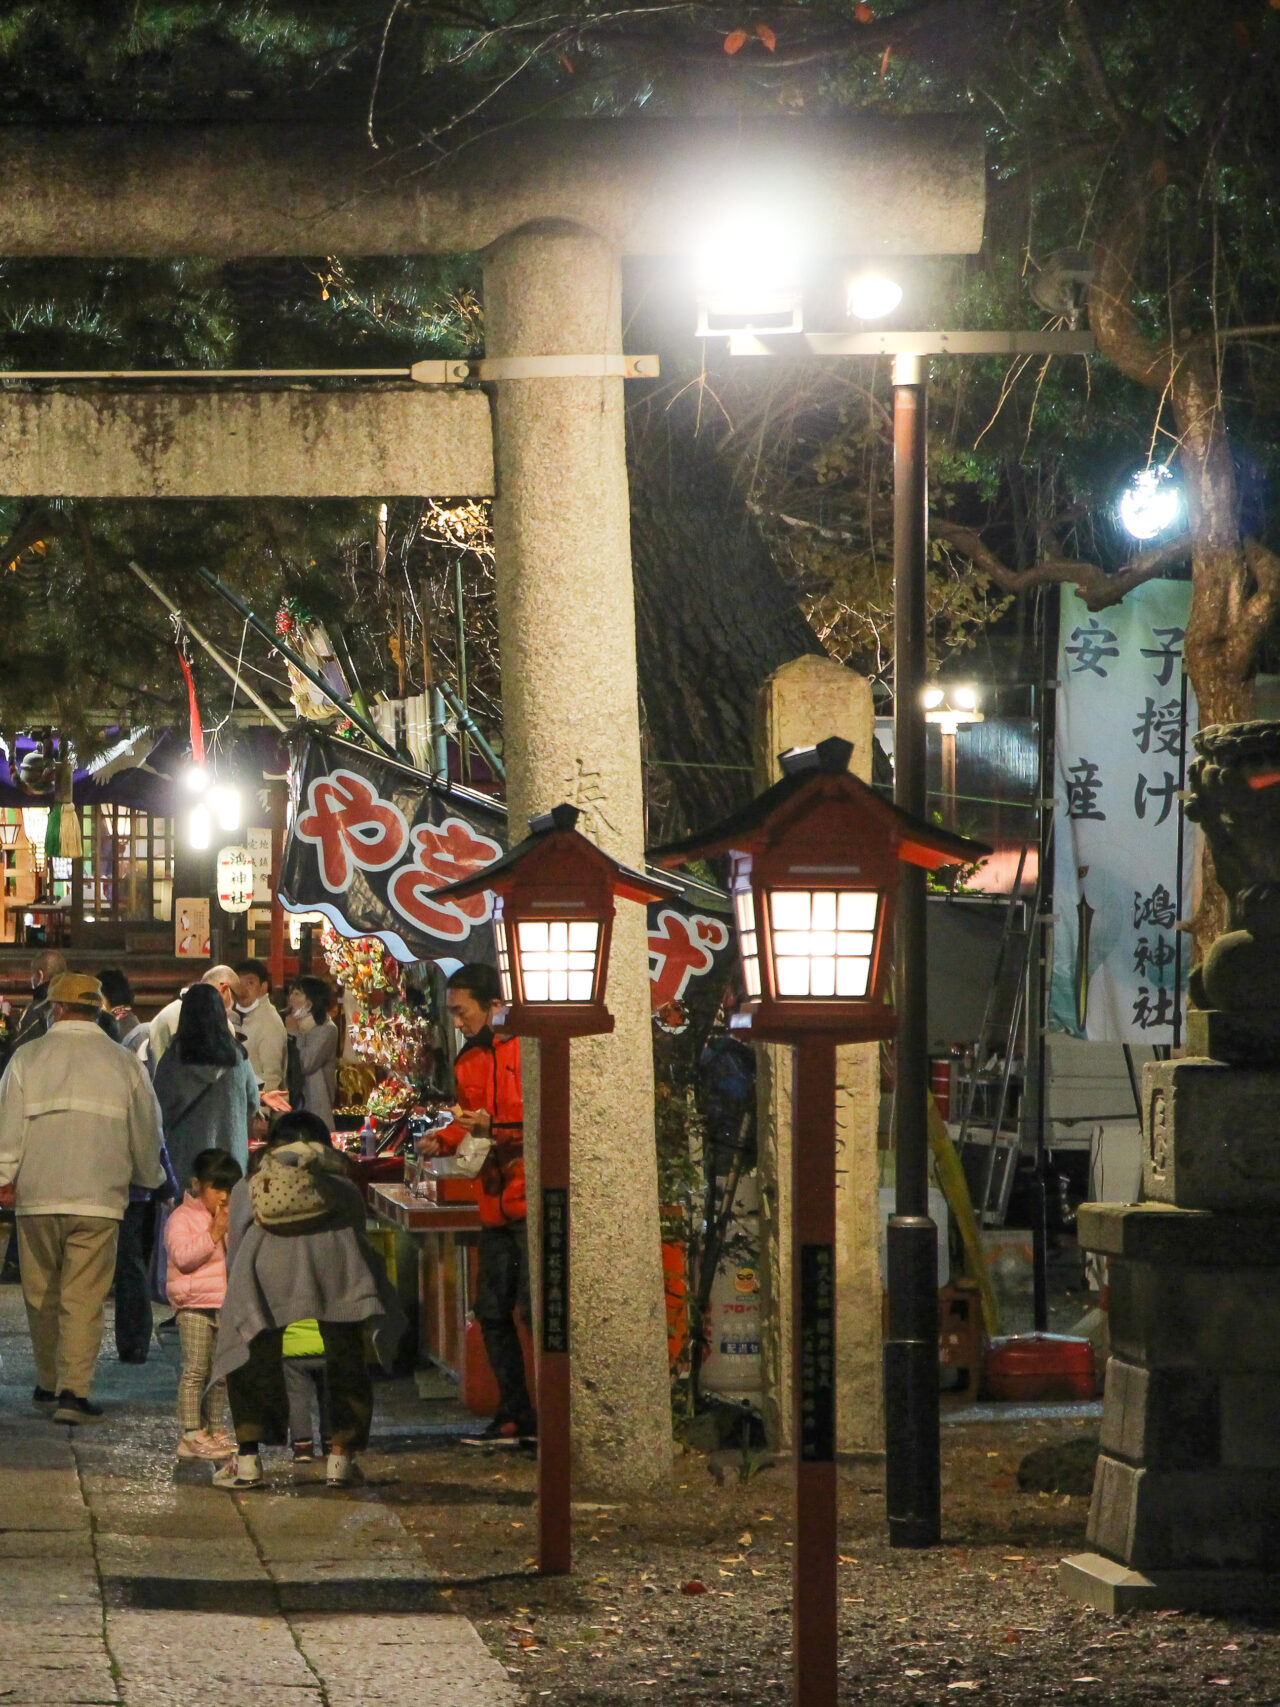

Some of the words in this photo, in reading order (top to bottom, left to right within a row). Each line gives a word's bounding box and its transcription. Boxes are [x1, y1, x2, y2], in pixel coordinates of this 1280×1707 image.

[1065, 617, 1121, 822] 安産
[1132, 626, 1189, 827] 子授け
[230, 852, 248, 905] 鴻神社
[1131, 883, 1182, 1030] 鴻神社
